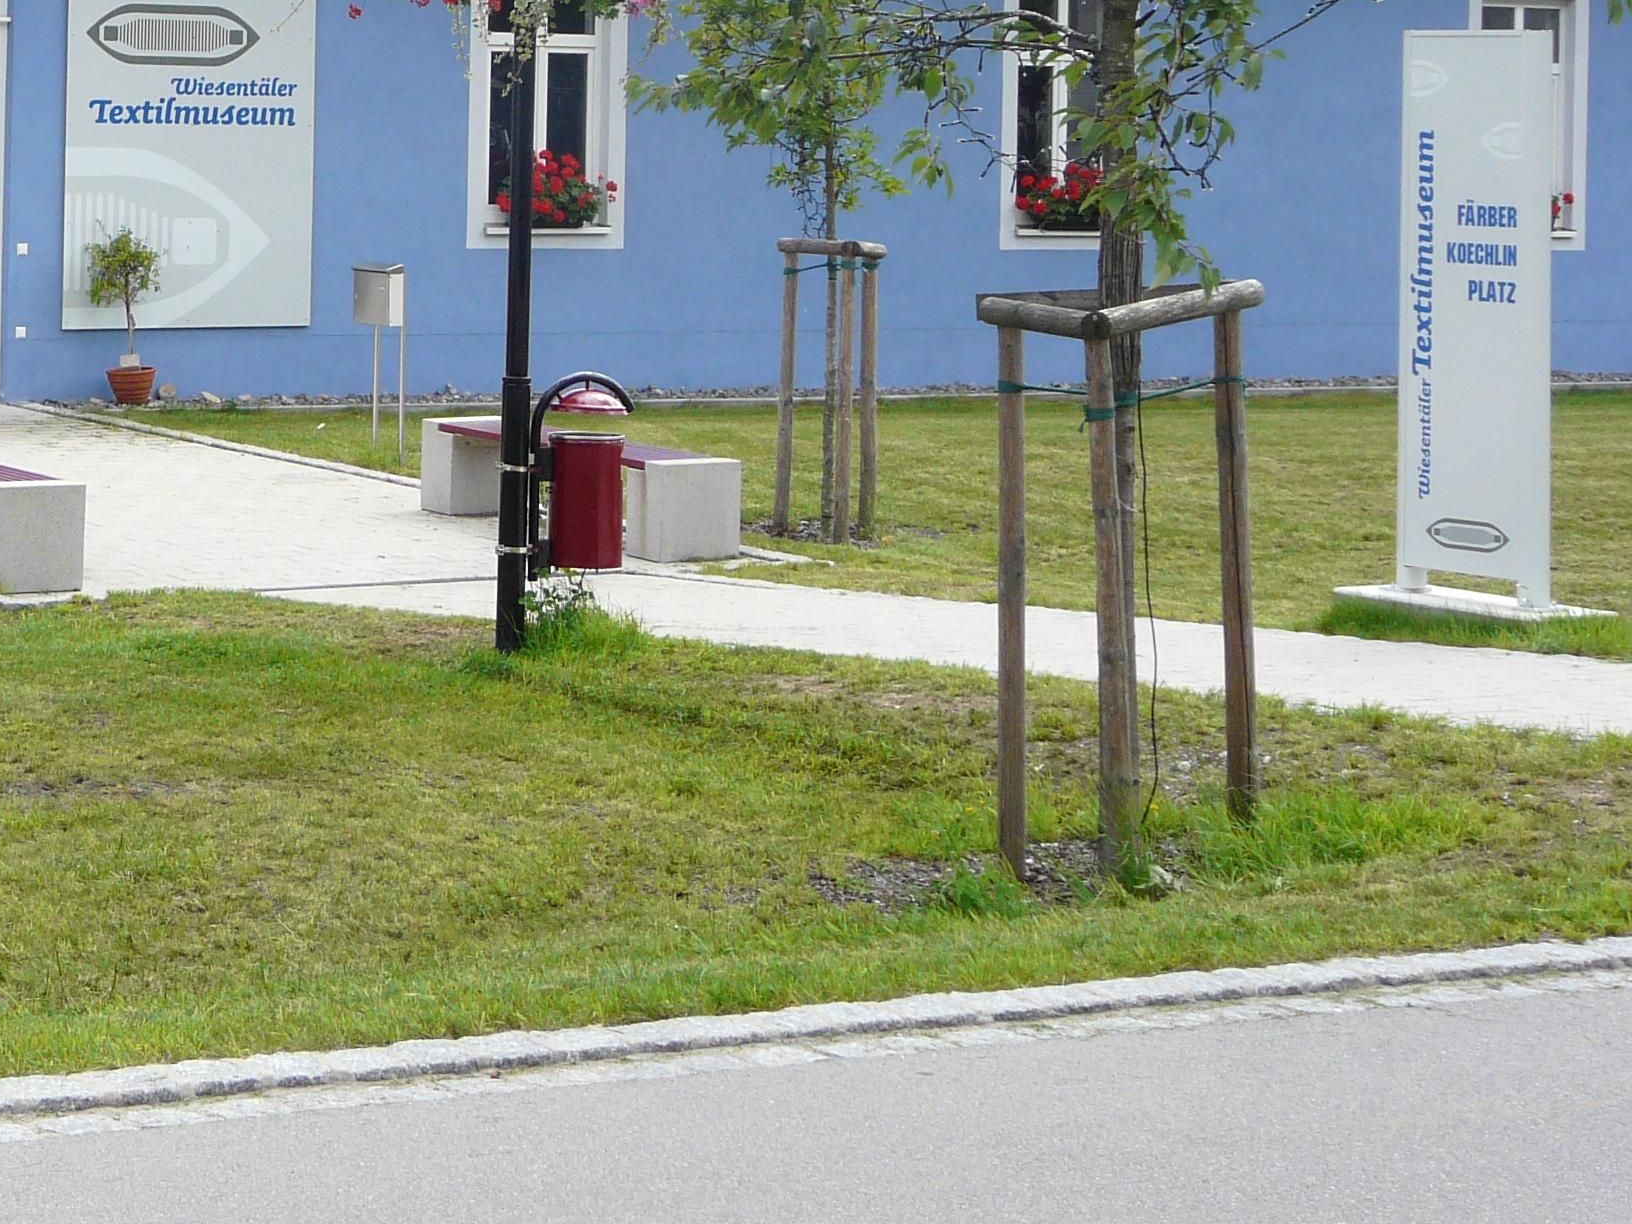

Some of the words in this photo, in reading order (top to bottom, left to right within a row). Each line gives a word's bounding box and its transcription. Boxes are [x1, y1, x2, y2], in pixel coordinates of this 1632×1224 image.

[171, 77, 298, 97] Wiesentäler
[89, 97, 296, 126] Textilmuseum
[1457, 199, 1517, 228] FÄRBER
[1411, 129, 1435, 376] Textilmuseum
[1447, 242, 1517, 266] KOECHLIN
[1468, 280, 1516, 303] PLATZ
[1417, 378, 1431, 500] Wiesentäler
